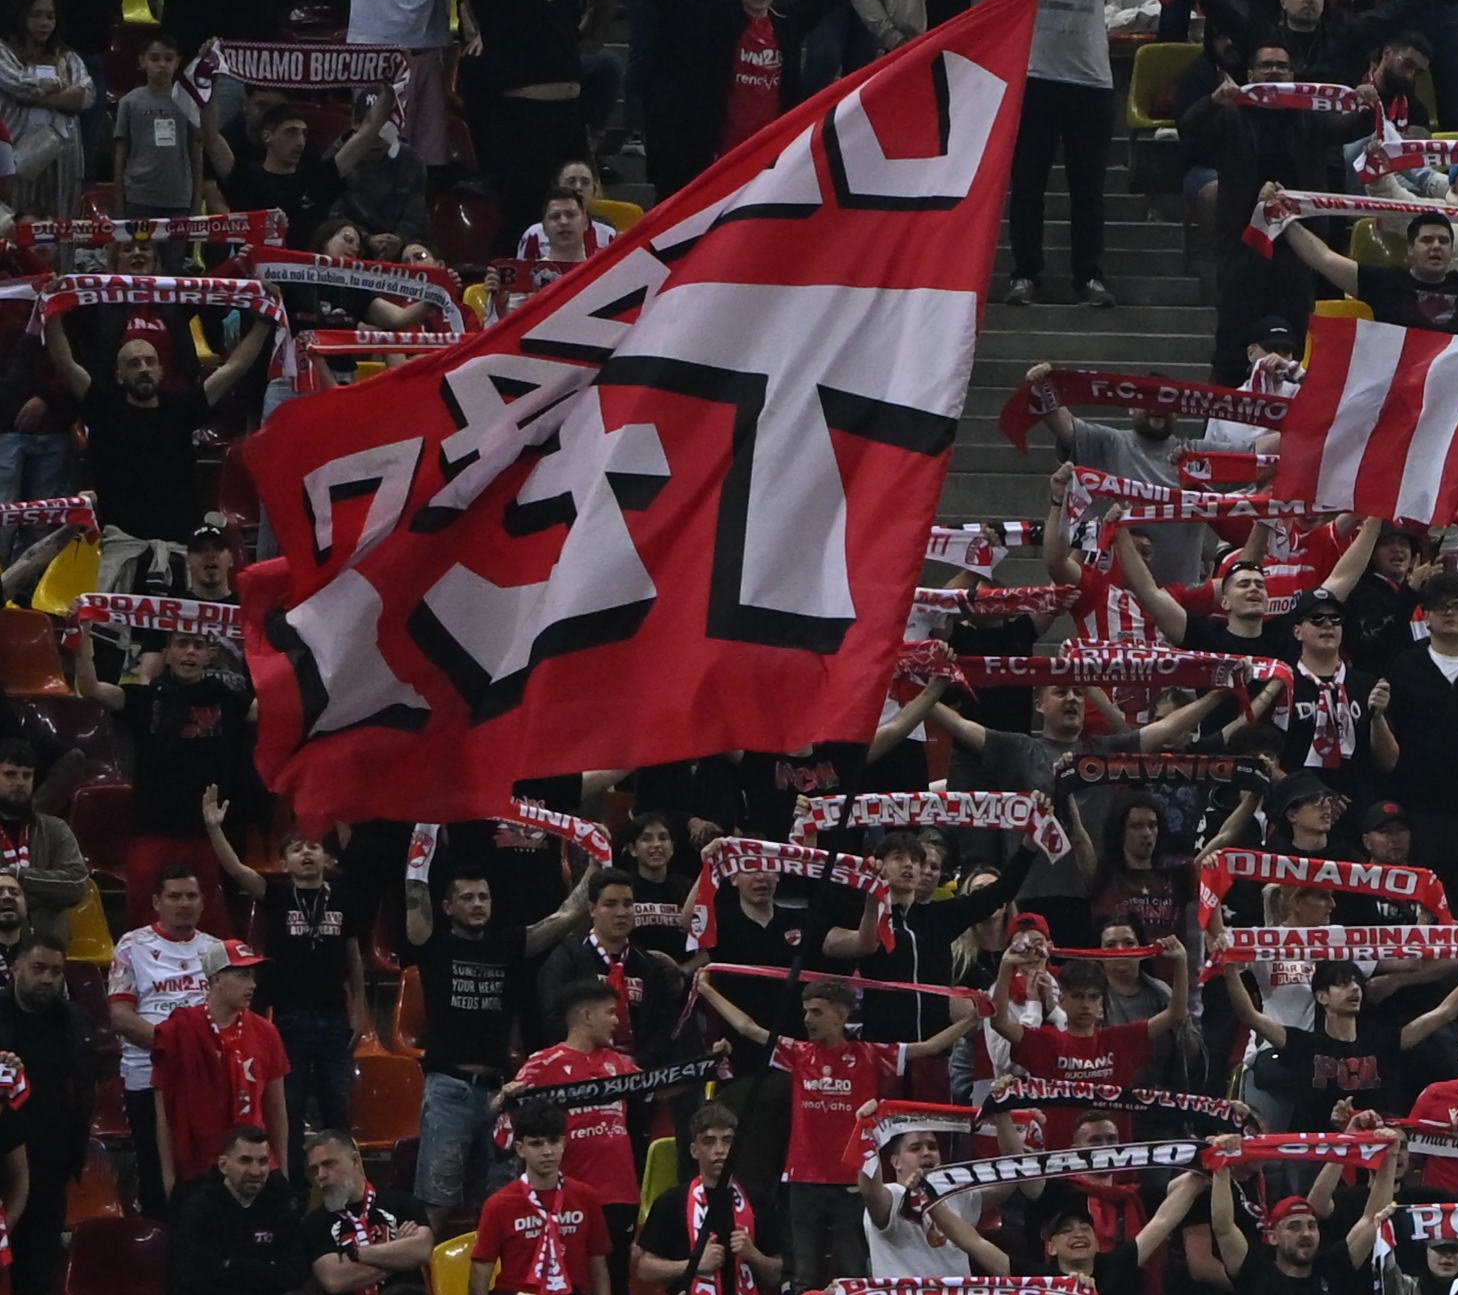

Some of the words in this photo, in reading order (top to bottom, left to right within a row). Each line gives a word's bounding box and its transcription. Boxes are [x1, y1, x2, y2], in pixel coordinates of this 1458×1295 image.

[225, 49, 303, 84] DINAMO
[30, 220, 116, 239] DINAMO
[77, 286, 276, 311] BUCURESTI
[1089, 379, 1144, 402] F.C.
[1156, 384, 1289, 423] DINAMO
[1081, 476, 1172, 503] CAINII
[984, 655, 1036, 676] F.C.
[1050, 654, 1179, 676] DINAMO
[1078, 759, 1237, 783] DINAMO
[1224, 850, 1420, 894] DINAMO
[1233, 926, 1326, 948] DOAR
[928, 1140, 1198, 1197] DINAMO
